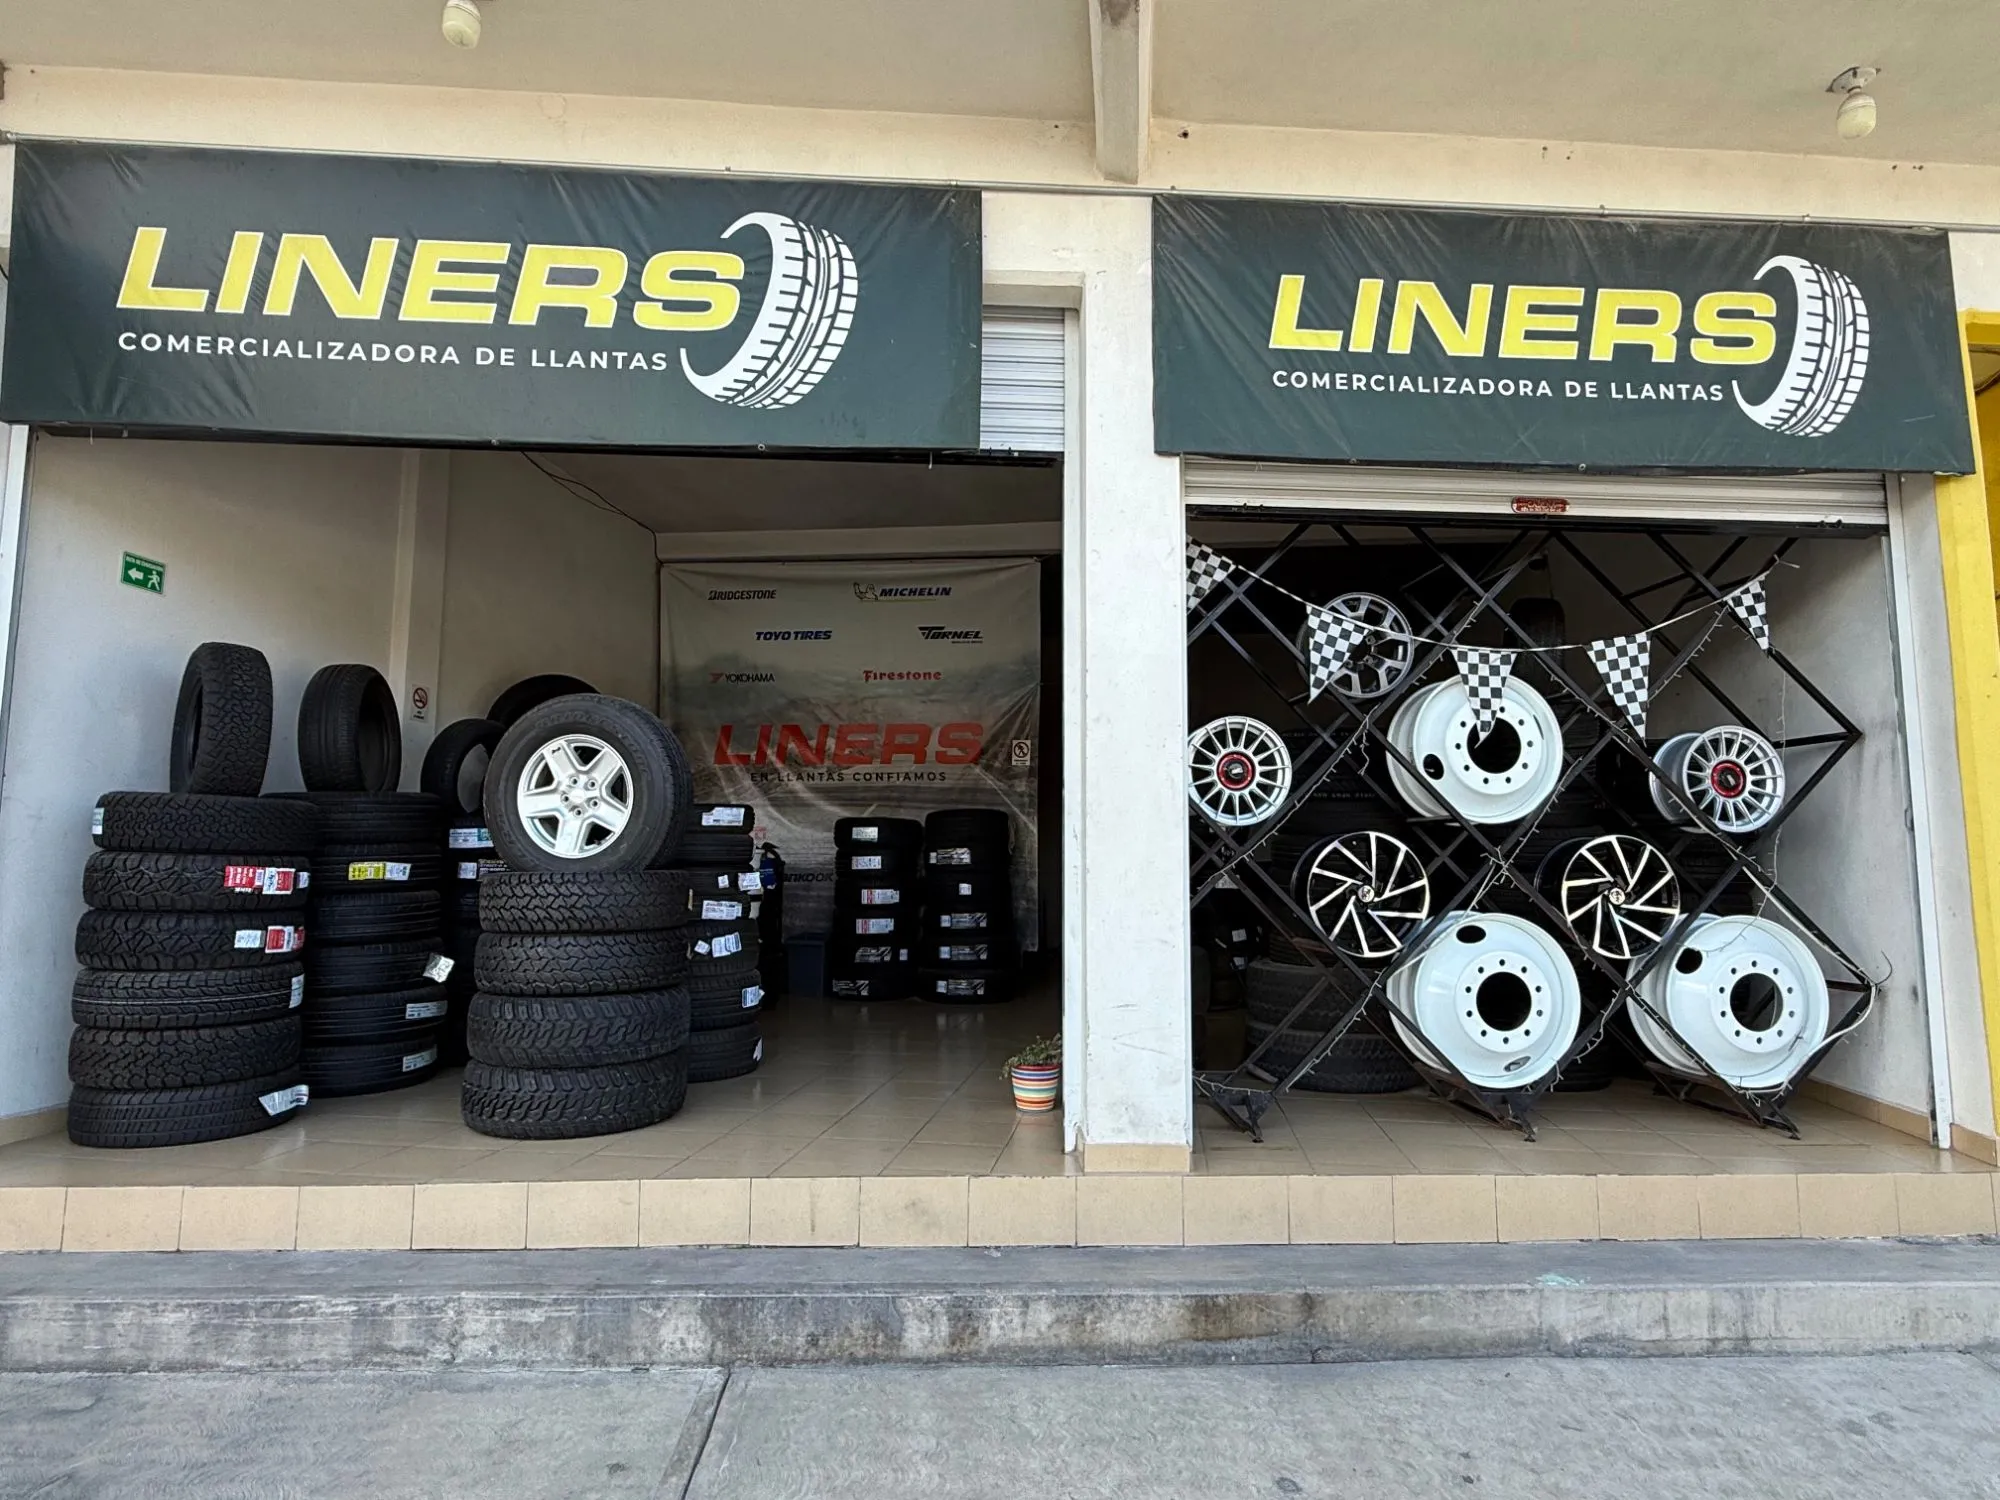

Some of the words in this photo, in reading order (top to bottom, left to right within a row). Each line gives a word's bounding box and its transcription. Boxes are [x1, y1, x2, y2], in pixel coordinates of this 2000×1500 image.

[116, 226, 743, 331] LINERS
[1269, 274, 1777, 365] LINERS
[117, 331, 461, 365] COMERCIALIZADORA
[475, 346, 516, 368] DE
[530, 348, 668, 372] LLANTAS
[1271, 369, 1554, 398] COMERCIALIZADORA
[1564, 380, 1599, 399] DE
[1610, 381, 1724, 403] LLANTAS
[707, 589, 777, 601] BRIDGESTONE
[879, 586, 952, 597] MICHELIN
[755, 631, 791, 641] TOYO
[793, 630, 833, 640] TIRES
[724, 672, 776, 683] YOKOHAMA
[862, 670, 942, 682] Firestone
[714, 723, 984, 765] LINERS
[750, 773, 769, 782] EN
[777, 771, 845, 782] LLANTAS
[852, 771, 947, 782] CONFIAMOS
